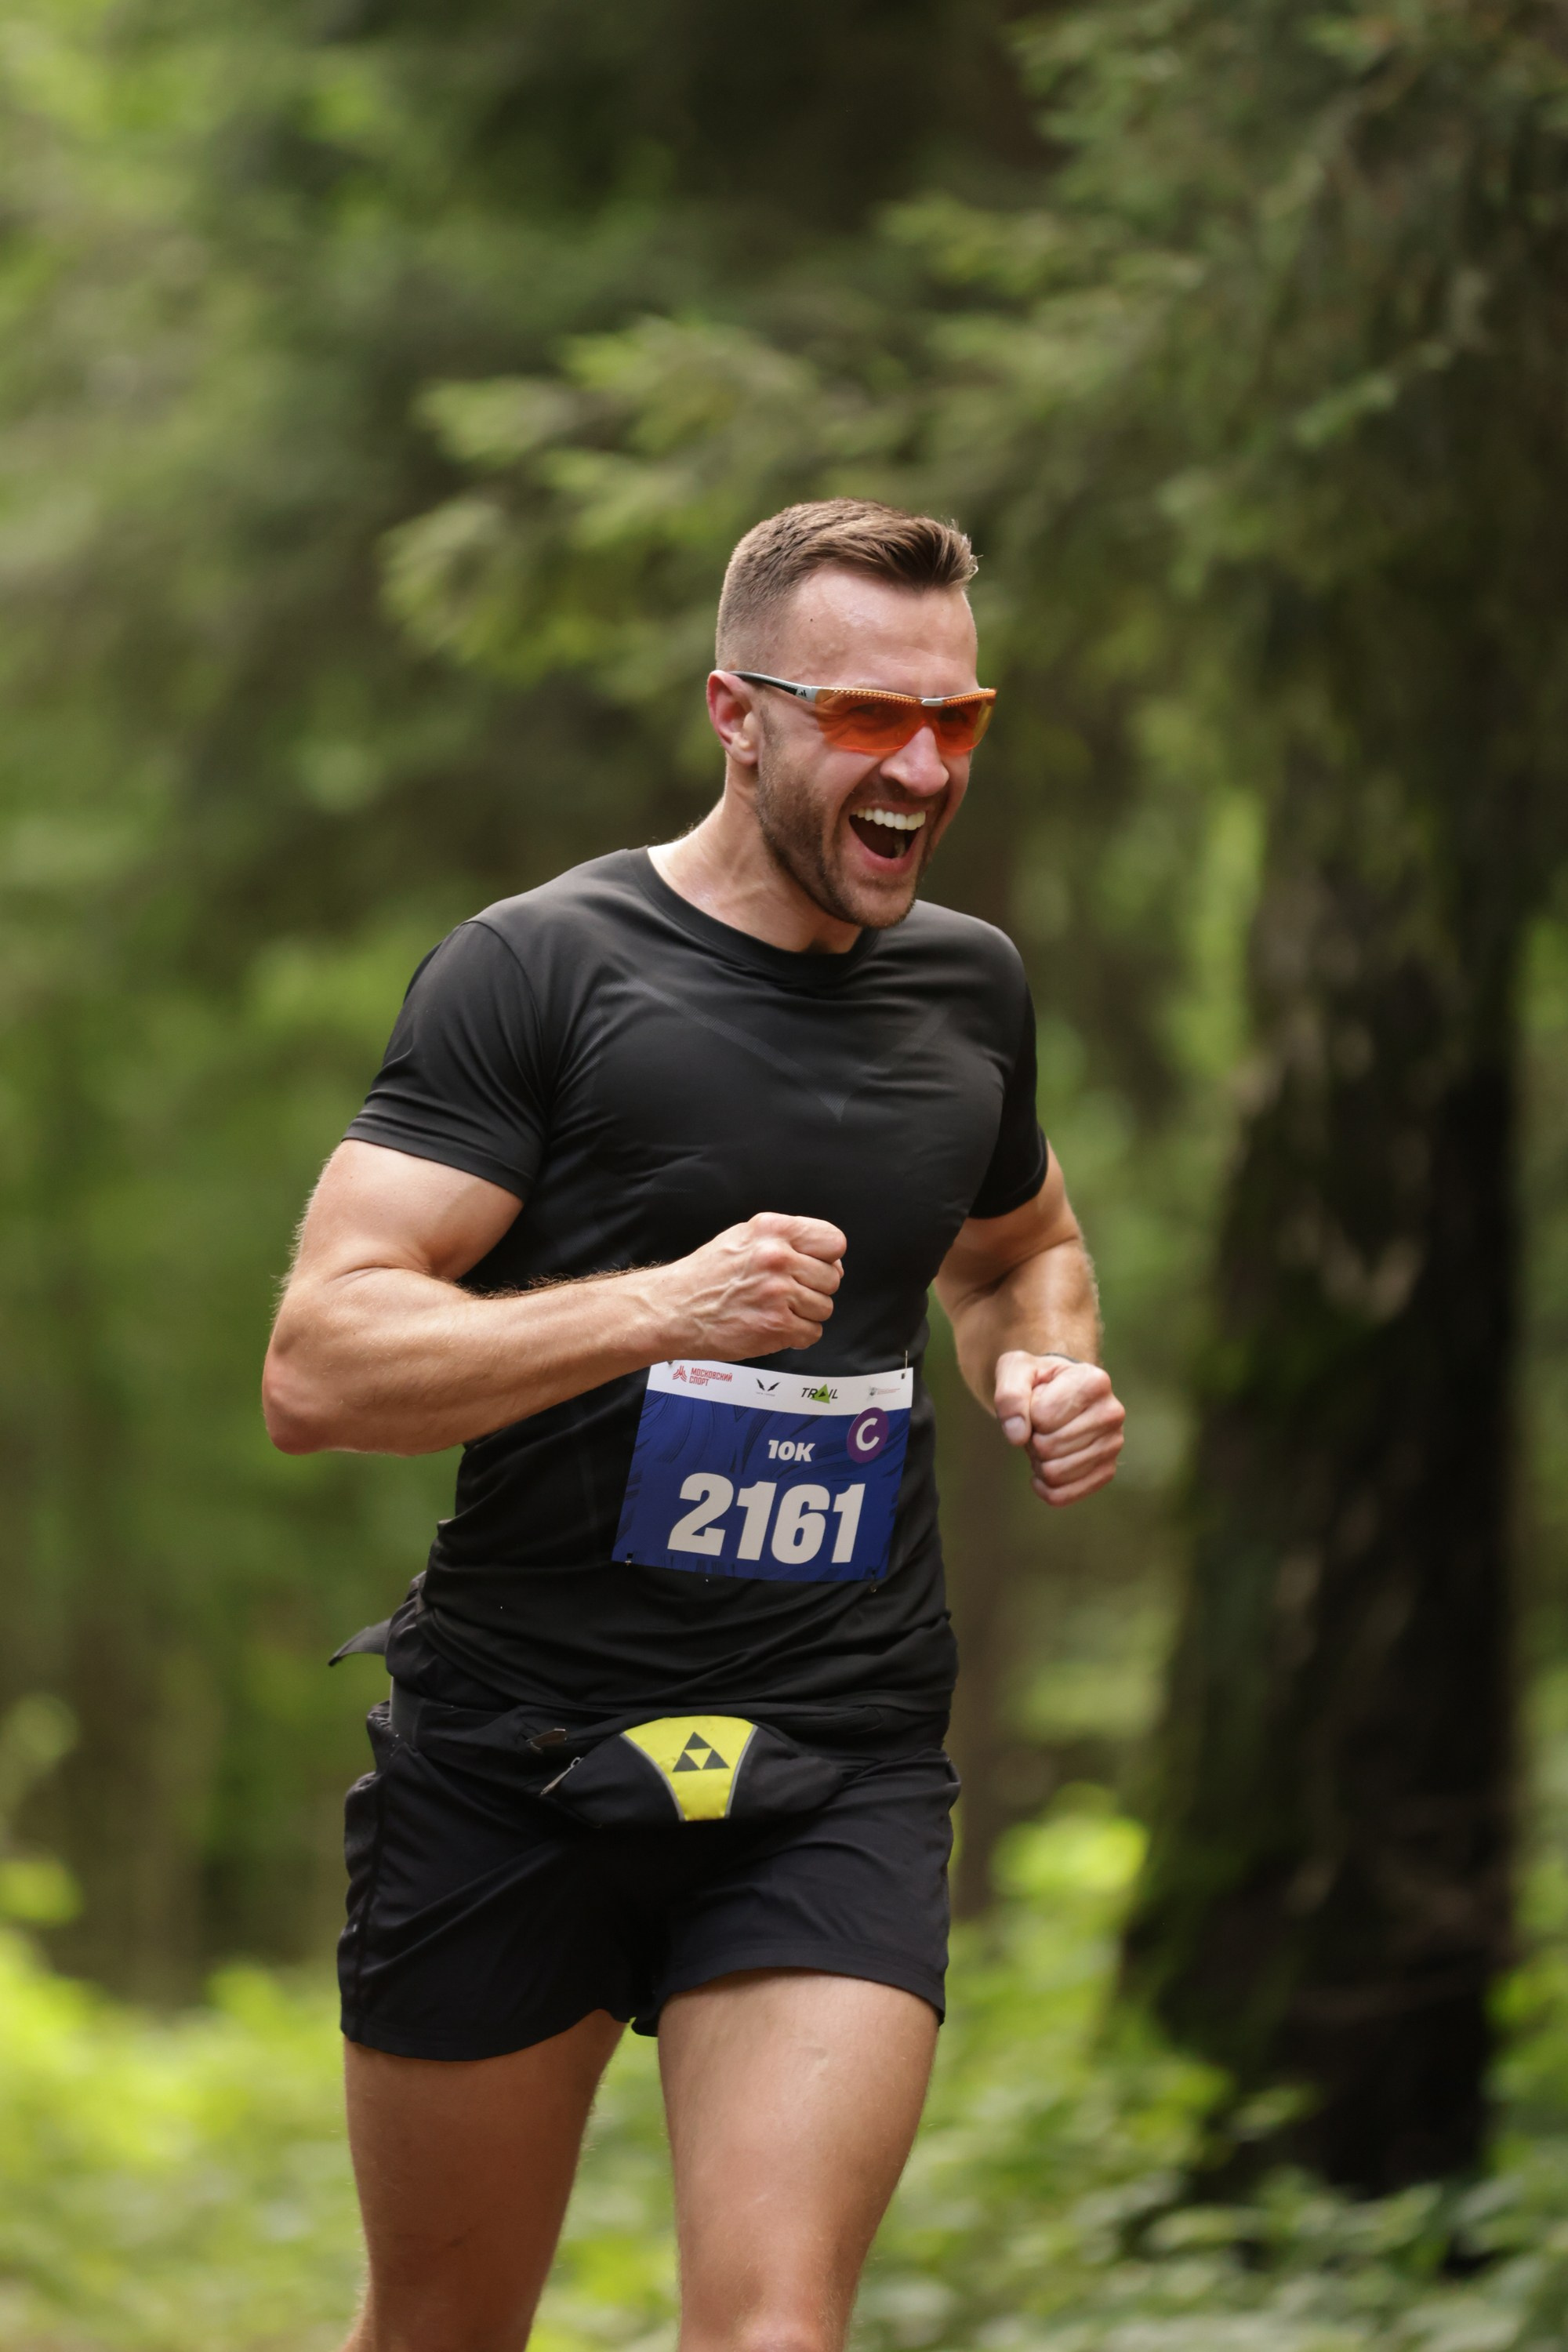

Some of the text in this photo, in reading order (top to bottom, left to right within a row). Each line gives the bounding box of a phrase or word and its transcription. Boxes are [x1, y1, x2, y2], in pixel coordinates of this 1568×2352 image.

[689, 1376, 710, 1386] СПОРТ
[691, 1367, 732, 1382] МОСКОВСКИЙ
[800, 1385, 839, 1403] TRAIL
[855, 1417, 880, 1451] C
[768, 1439, 815, 1462] 10K
[667, 1472, 866, 1564] 2161
